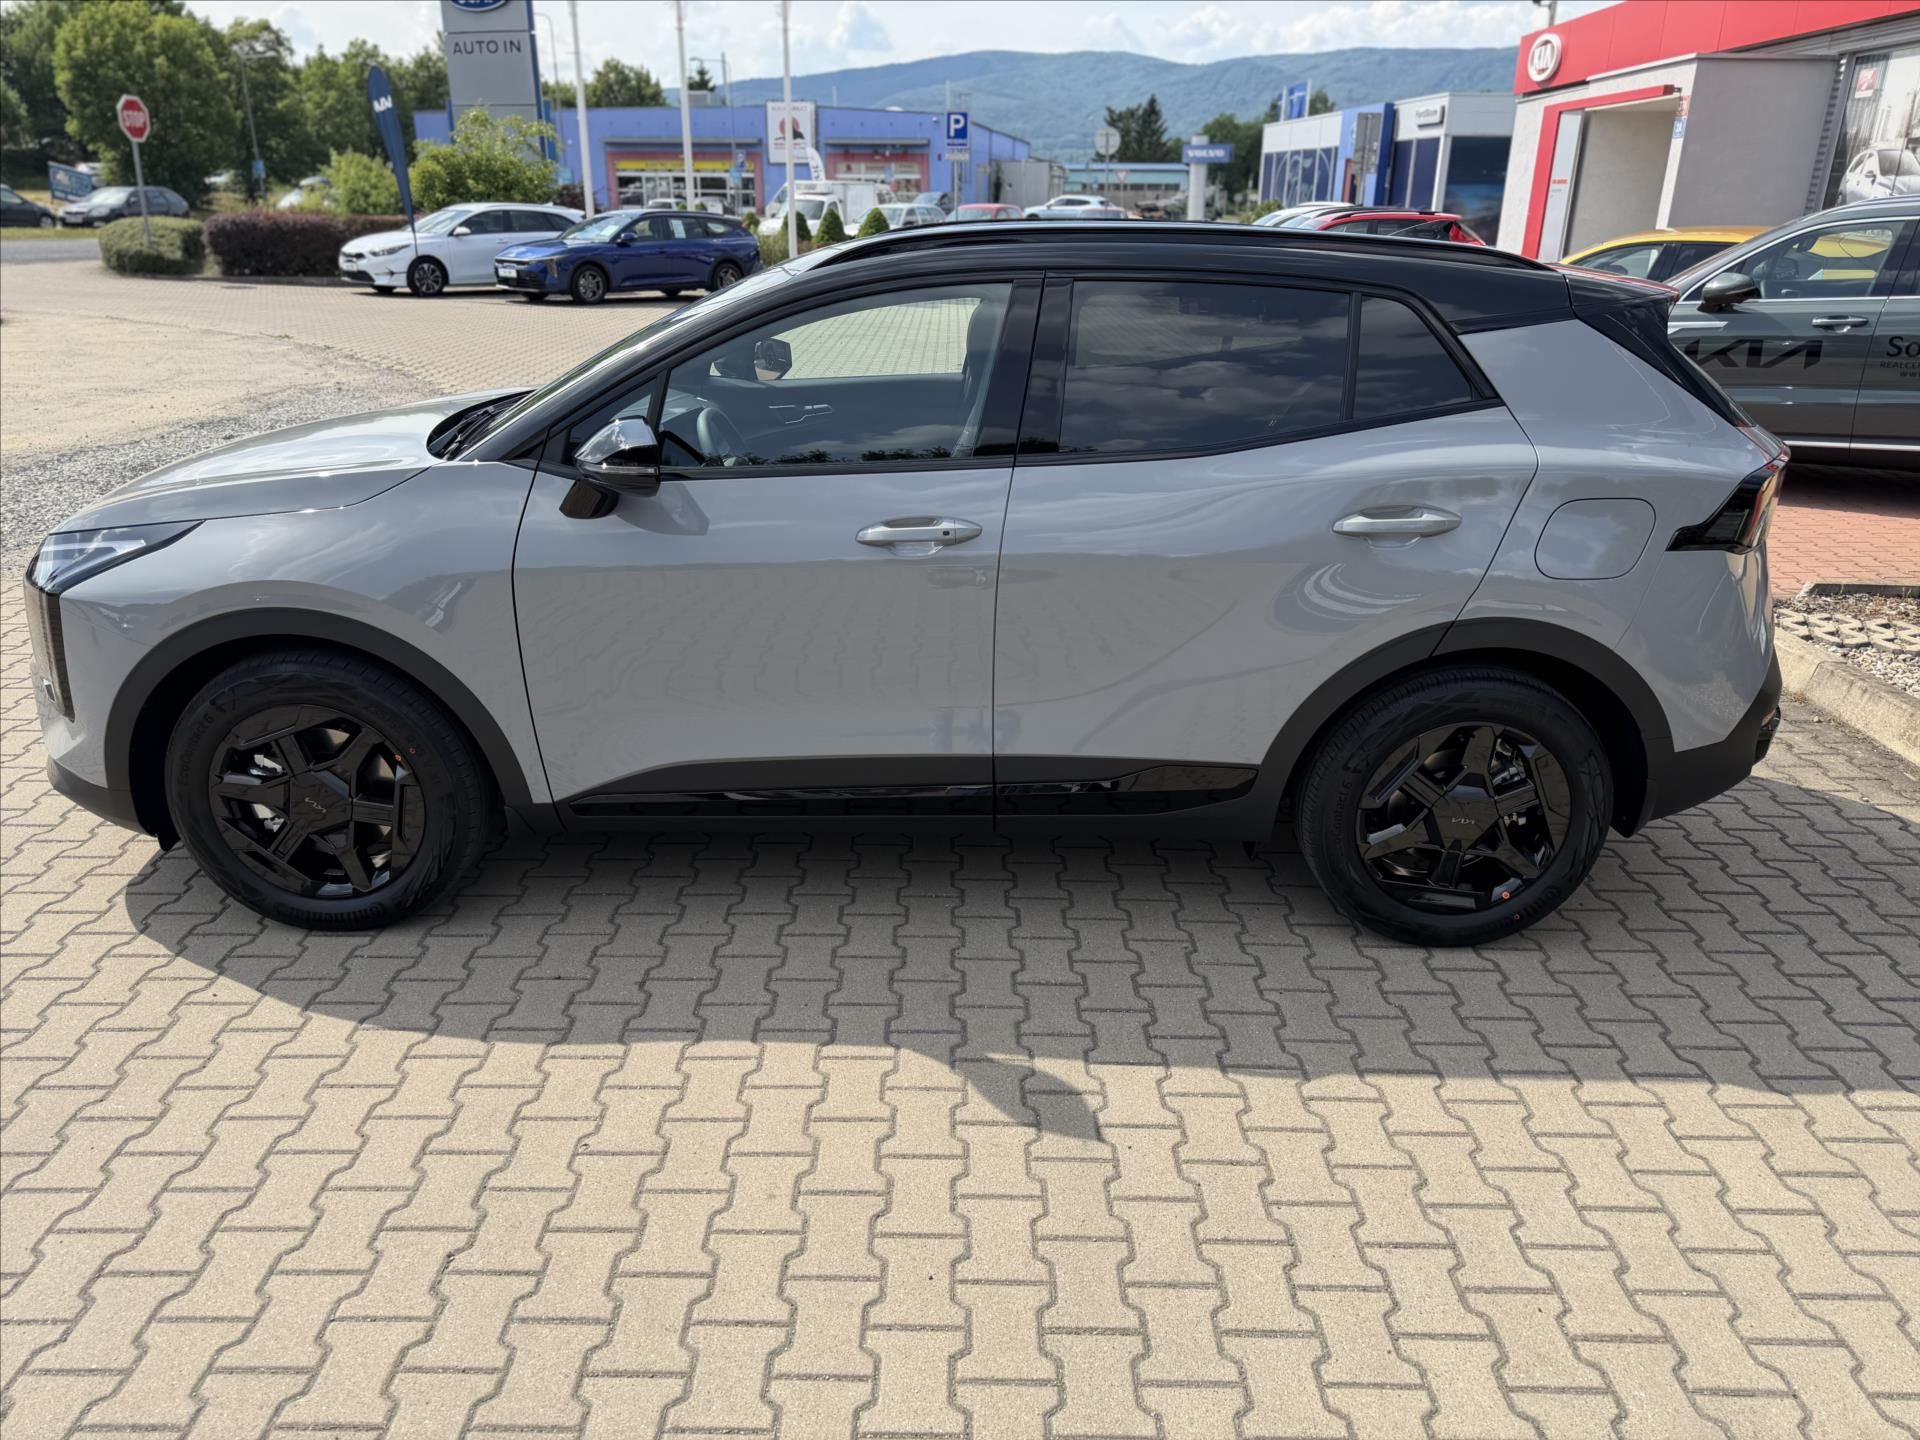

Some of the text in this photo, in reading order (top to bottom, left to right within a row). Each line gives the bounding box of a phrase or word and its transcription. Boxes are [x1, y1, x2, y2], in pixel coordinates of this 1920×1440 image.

[453, 40, 522, 55] AUTO IN
[1534, 43, 1555, 70] KIA
[122, 110, 146, 128] STOP
[949, 114, 965, 137] P
[1187, 149, 1225, 158] VOLVO
[1683, 338, 1823, 369] KIA
